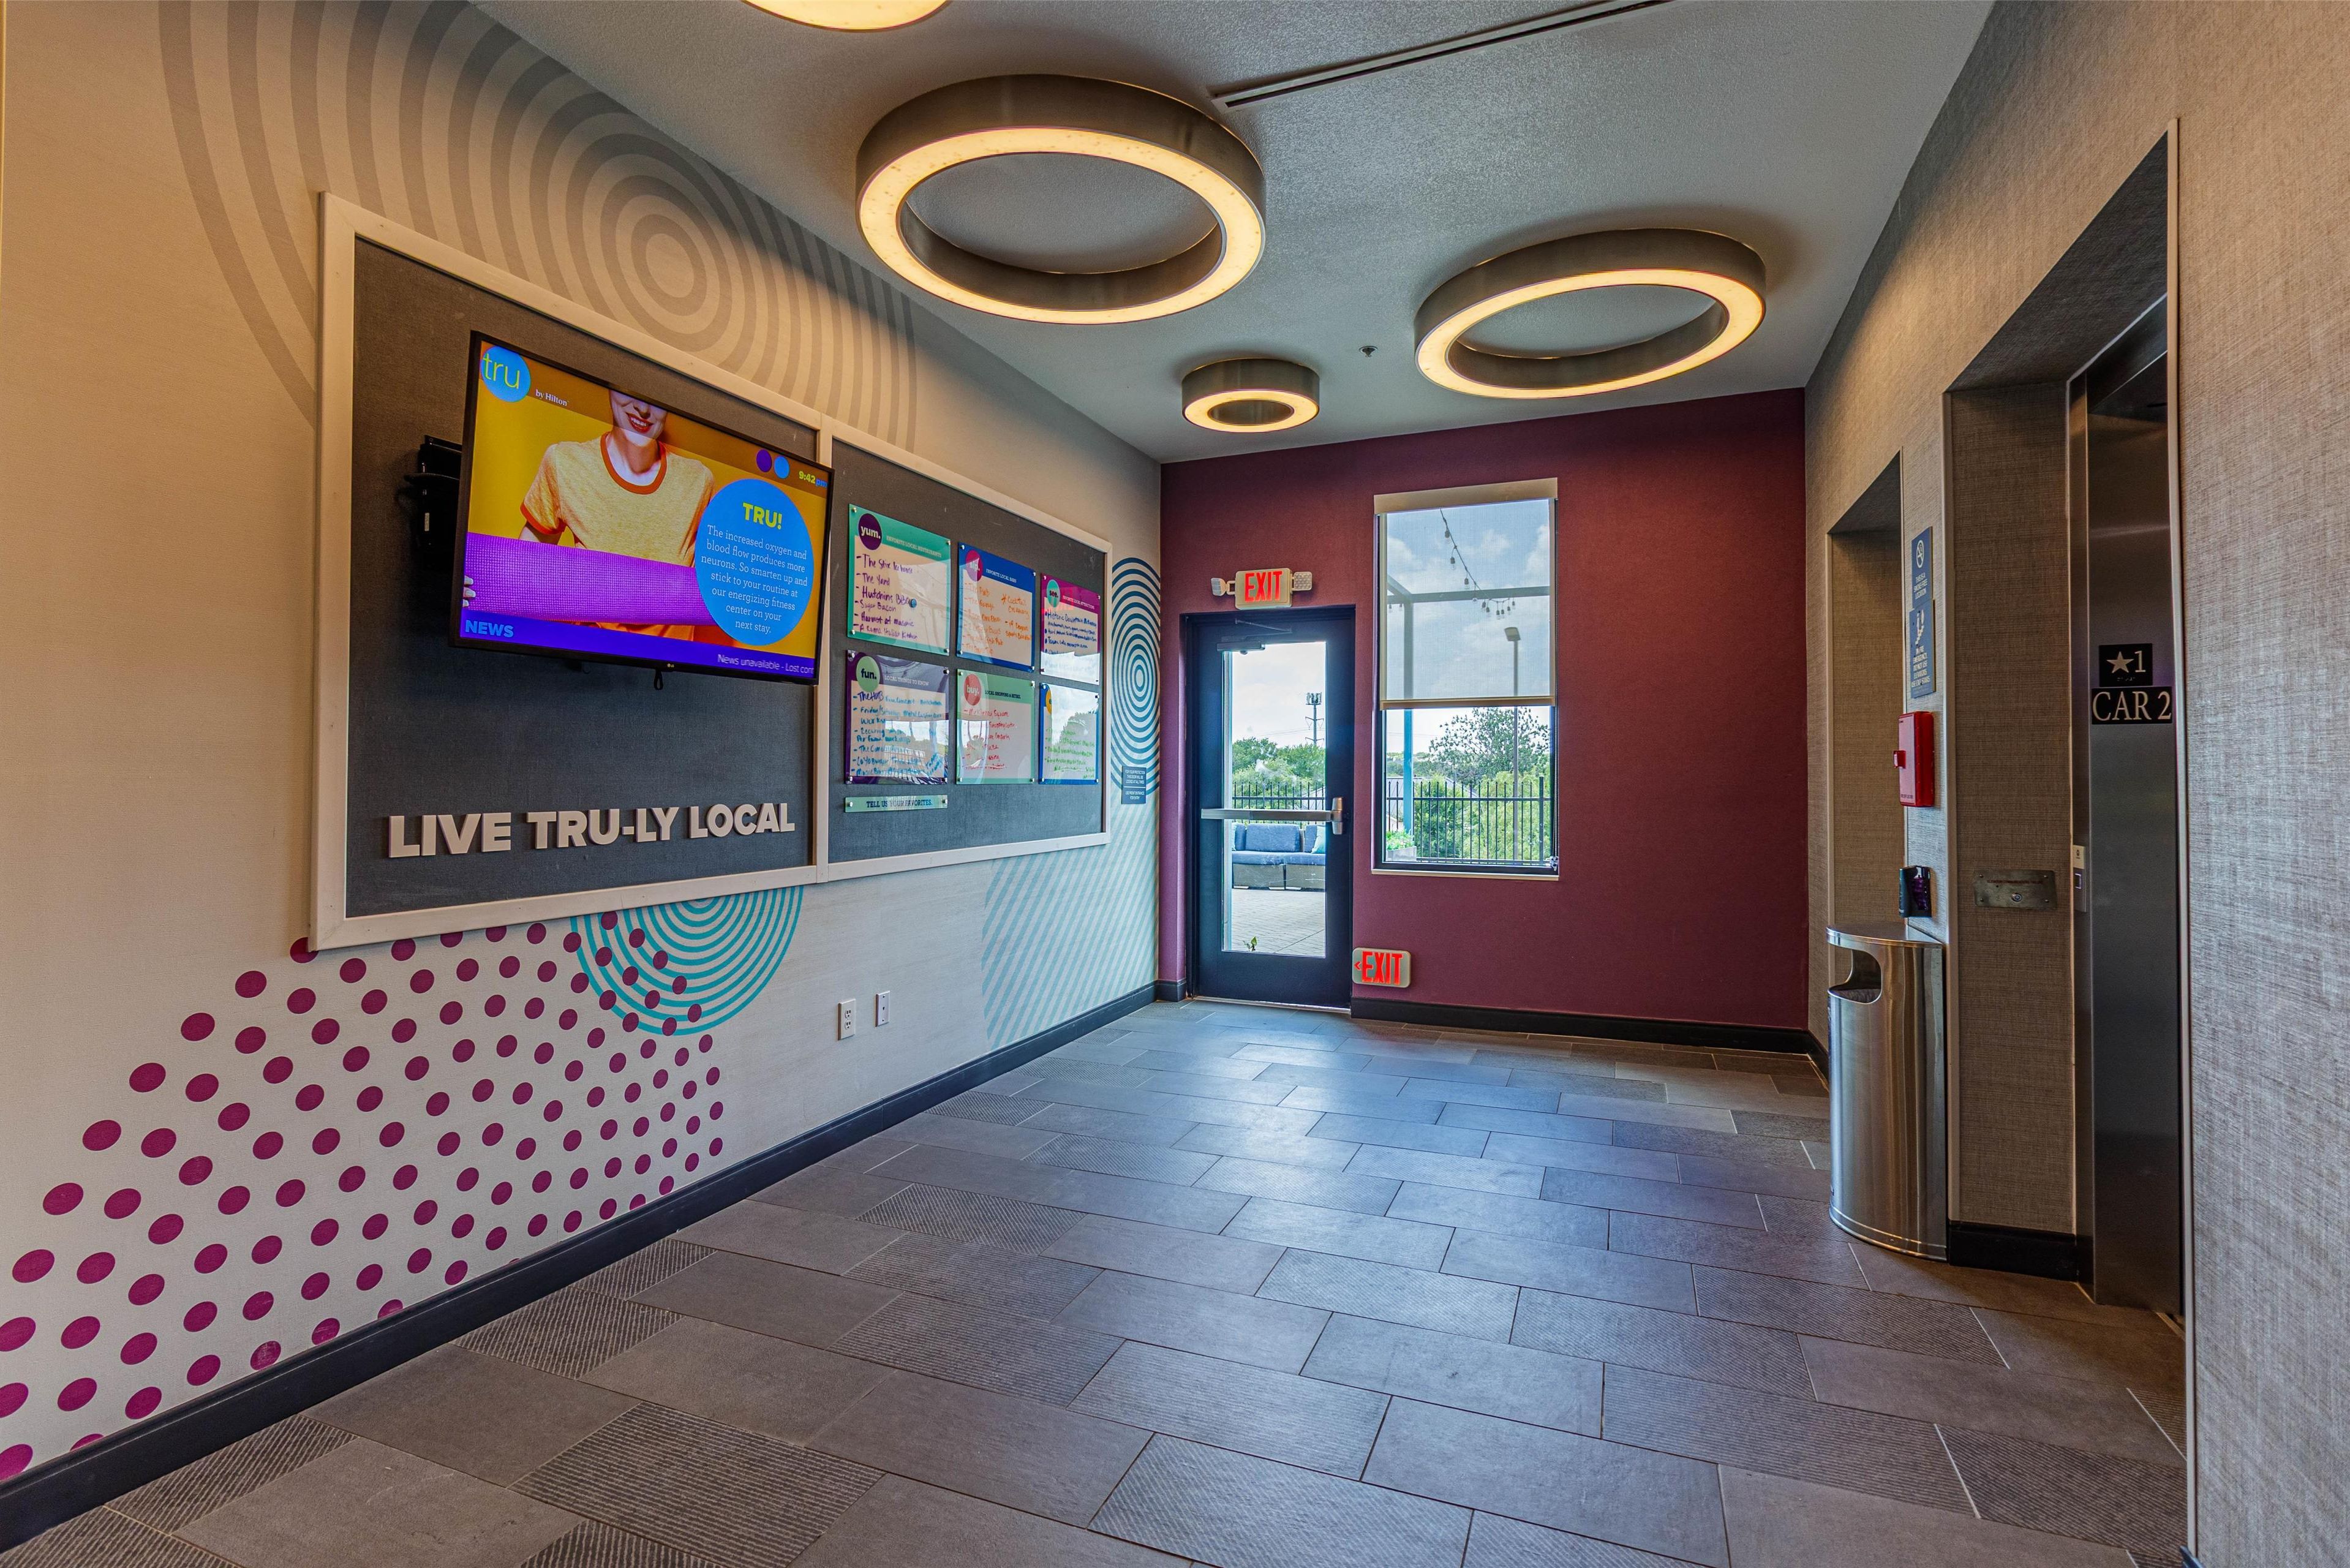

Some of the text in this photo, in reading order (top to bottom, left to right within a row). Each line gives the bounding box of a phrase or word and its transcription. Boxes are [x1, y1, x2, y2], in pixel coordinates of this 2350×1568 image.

[483, 353, 520, 390] tru
[535, 389, 568, 407] by Hilton
[799, 470, 827, 488] 9:42 pm
[742, 502, 783, 530] TRU!
[707, 525, 807, 560] The increased oxygen and
[861, 526, 881, 540] yum.
[707, 539, 805, 573] blood flow produces more
[862, 554, 876, 568] The
[701, 556, 737, 570] neurons.
[739, 562, 749, 573] So
[751, 567, 782, 581] smarten
[794, 577, 807, 586] and
[862, 573, 874, 584] The
[710, 572, 731, 583] stick
[733, 576, 741, 585] to
[743, 580, 761, 589] your
[763, 584, 789, 596] routine
[1245, 570, 1283, 603] EXIT
[712, 587, 796, 611] our energizing fitness
[726, 605, 781, 620] center on your
[465, 619, 514, 638] NEWS
[736, 620, 771, 635] next stay.
[717, 654, 739, 665] News
[740, 658, 780, 670] unavailable
[785, 663, 799, 672] Lost
[2134, 650, 2146, 673] 1
[861, 668, 877, 680] fun.
[966, 685, 980, 696] buy.
[2092, 691, 2172, 722] CAR 2
[388, 802, 796, 858] LIVE TRU-LY LOCAL
[1361, 951, 1403, 986] EXIT
